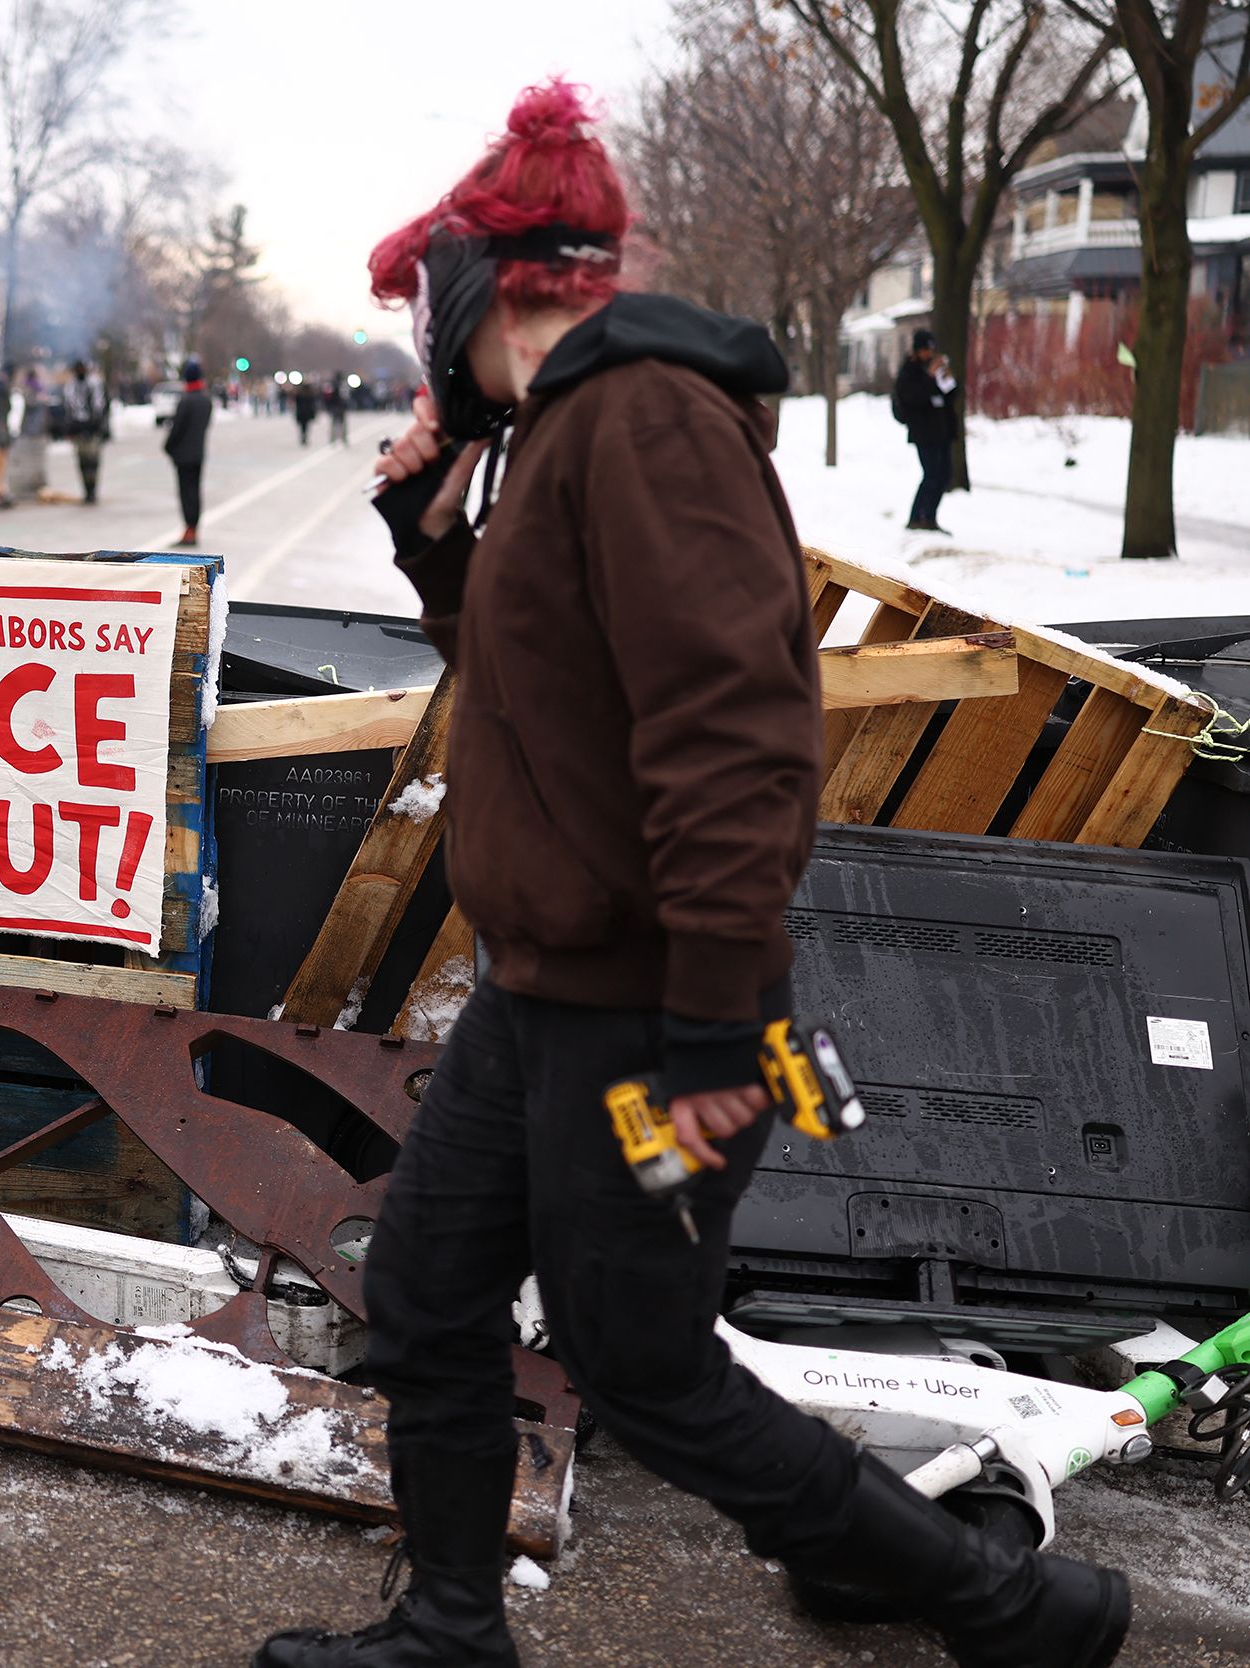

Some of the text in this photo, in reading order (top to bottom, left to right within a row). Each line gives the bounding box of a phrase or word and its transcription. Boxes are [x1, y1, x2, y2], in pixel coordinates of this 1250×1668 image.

[96, 624, 154, 655] SAY
[219, 787, 316, 811] PROPERTY
[321, 794, 347, 812] OF
[246, 810, 374, 833] OF MINNEAPO
[803, 1370, 981, 1399] On Lime + Uber
